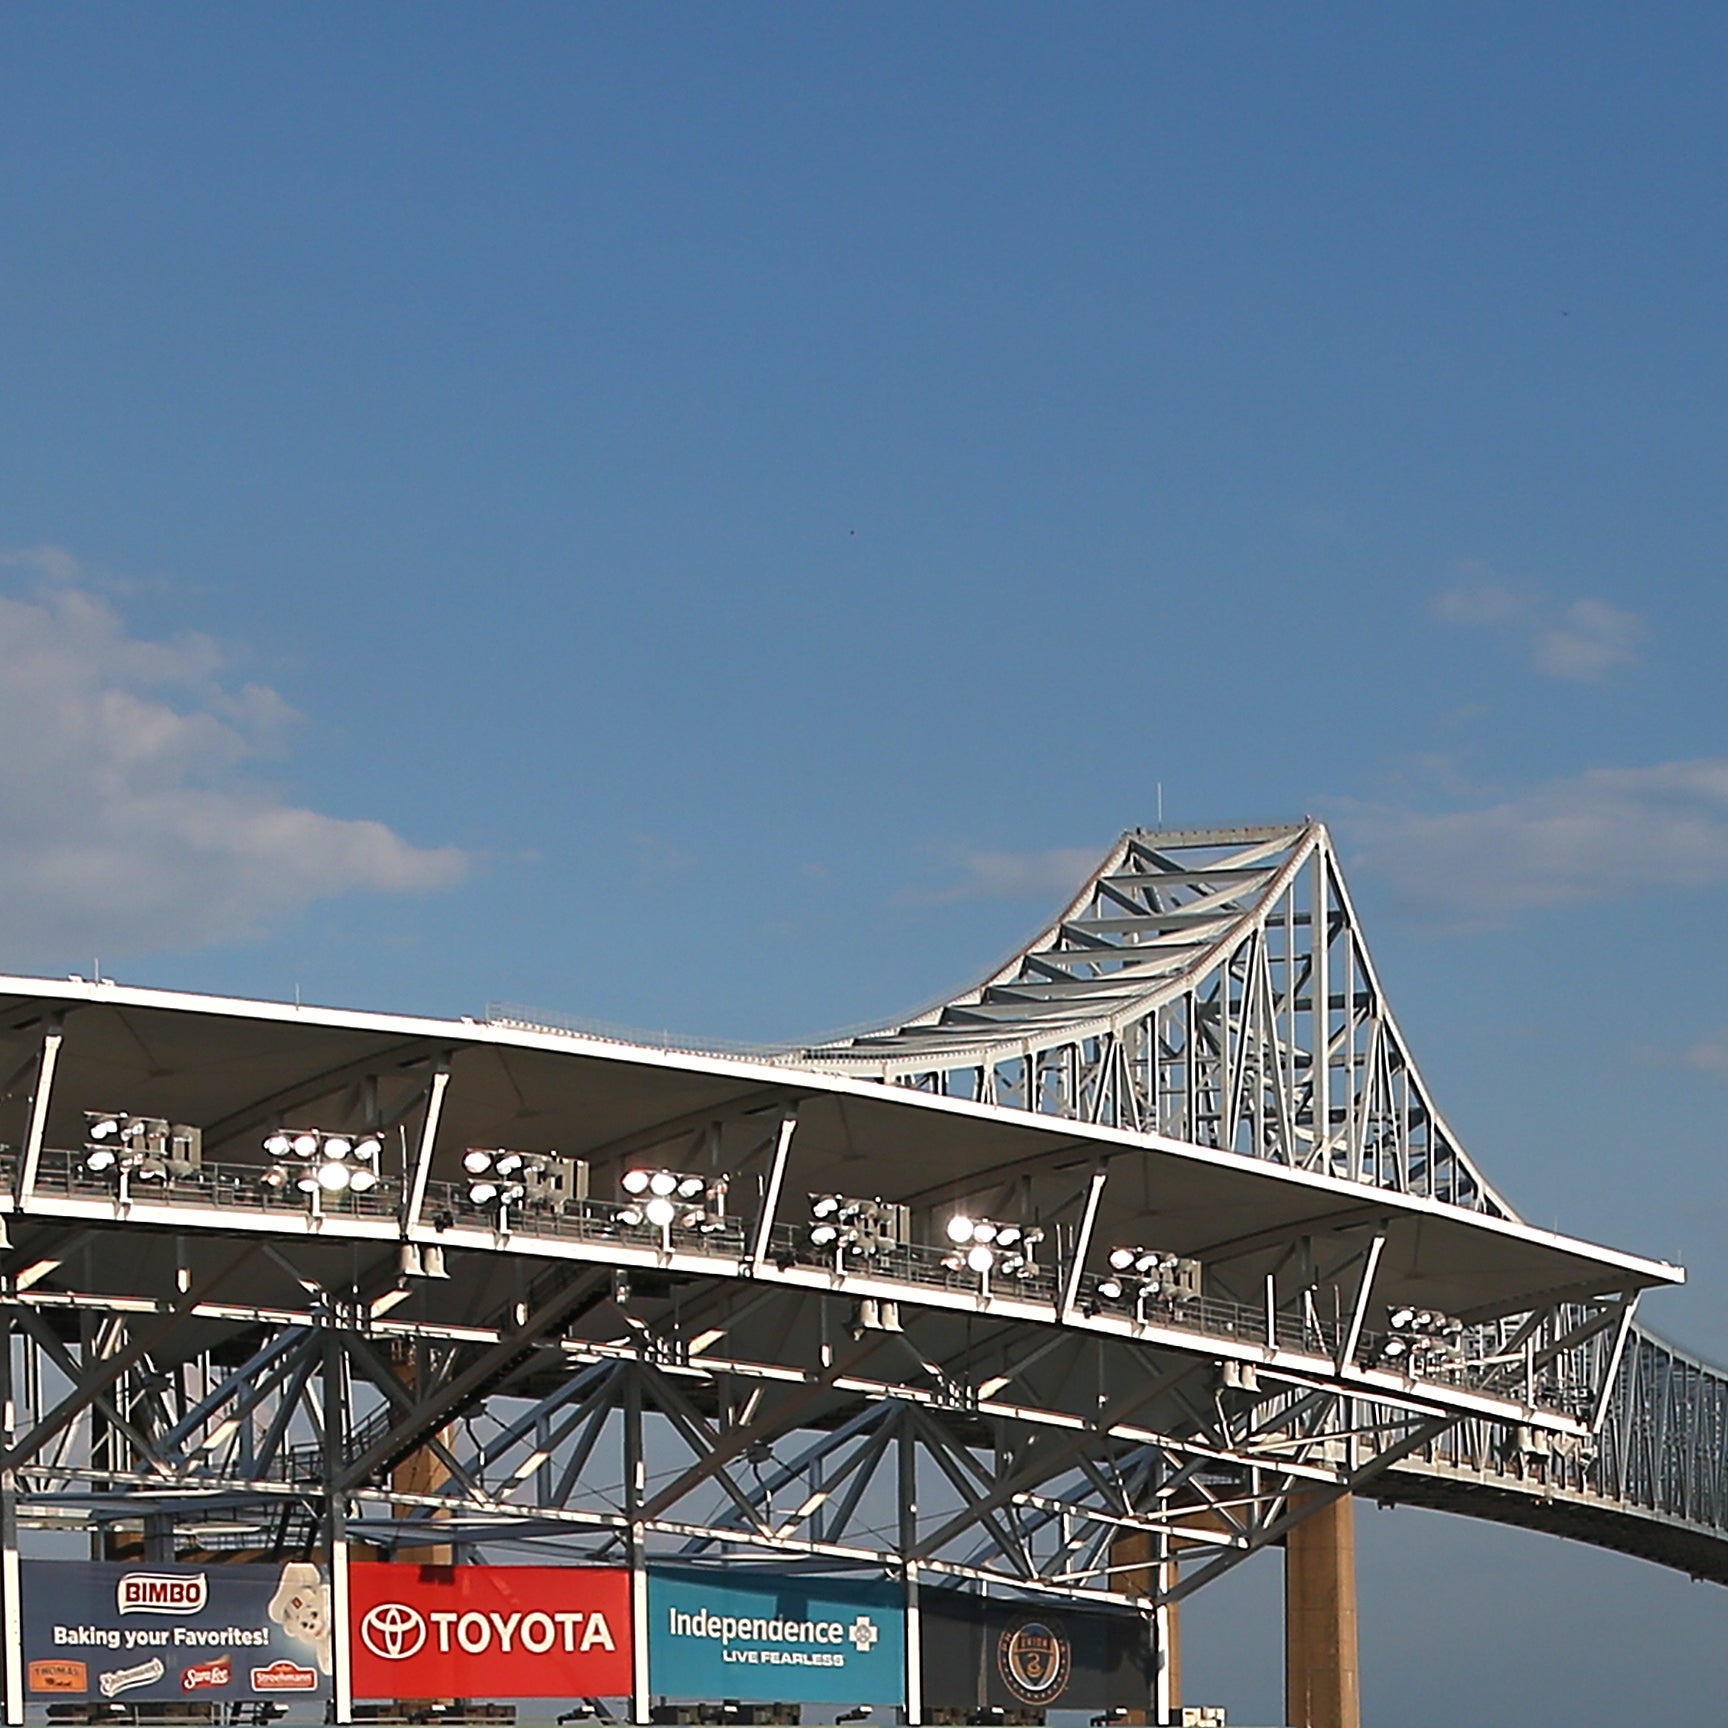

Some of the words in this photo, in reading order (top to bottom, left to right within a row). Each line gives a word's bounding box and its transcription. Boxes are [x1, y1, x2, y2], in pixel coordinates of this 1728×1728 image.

[125, 1582, 201, 1603] BIMBO
[54, 1626, 121, 1649] Baking
[124, 1630, 169, 1649] your
[173, 1627, 270, 1647] Favorites!
[430, 1611, 616, 1653] TOYOTA
[669, 1607, 844, 1646] Independence
[722, 1650, 759, 1664] LIVE
[761, 1651, 845, 1667] FEARLESS
[184, 1668, 211, 1689] Sara
[211, 1667, 229, 1684] Lee
